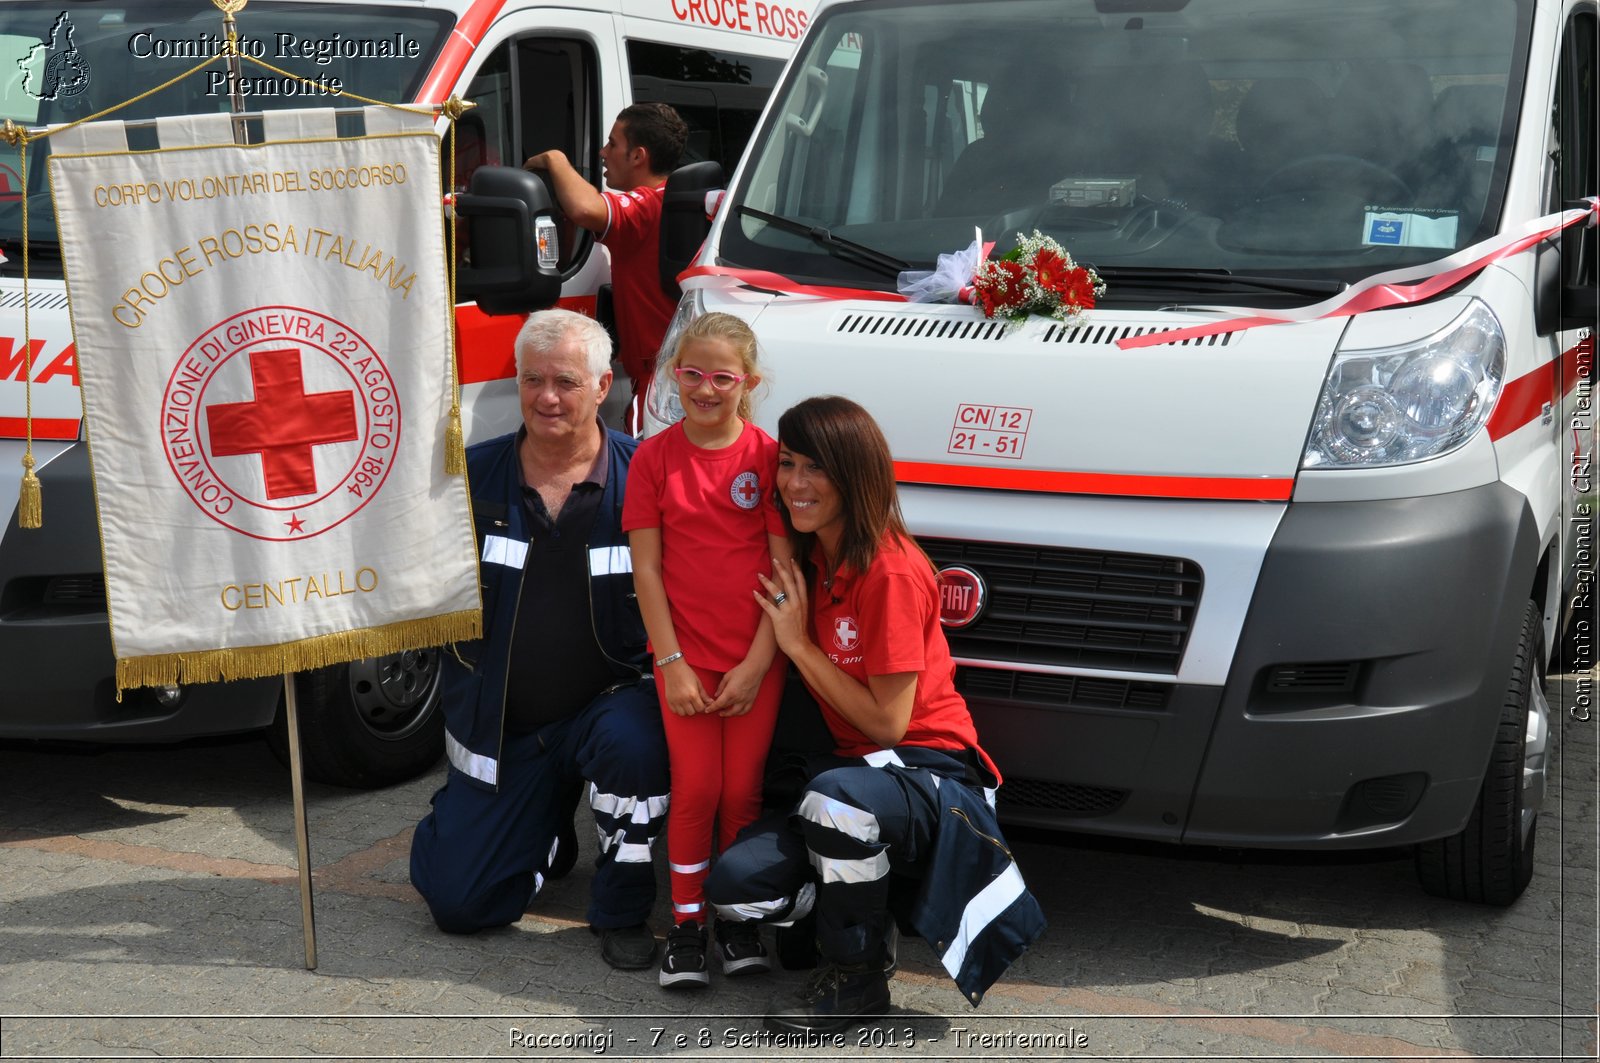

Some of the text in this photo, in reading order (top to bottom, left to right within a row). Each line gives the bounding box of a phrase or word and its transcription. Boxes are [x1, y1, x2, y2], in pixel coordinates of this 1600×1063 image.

[95, 163, 408, 207] CORPO VOLONTARI DEL SOCCORSO
[112, 223, 417, 328] CROCE ROSSA ITALIANA
[167, 315, 394, 514] CONVENZIONE DI GINEVRA 22 AGOSTO 1864
[960, 407, 1022, 429] CN 12
[953, 432, 976, 450] 21
[995, 435, 1019, 454] 51
[221, 567, 378, 612] CENTALLO
[940, 584, 972, 611] FIAT
